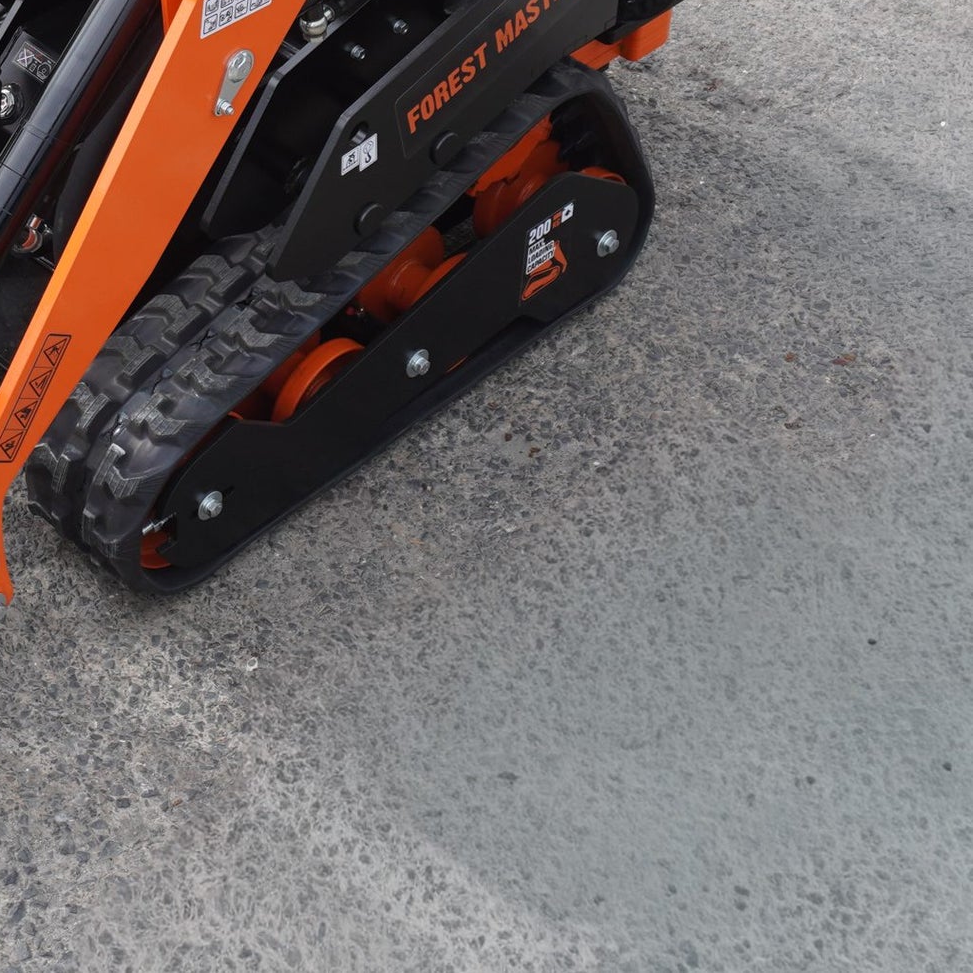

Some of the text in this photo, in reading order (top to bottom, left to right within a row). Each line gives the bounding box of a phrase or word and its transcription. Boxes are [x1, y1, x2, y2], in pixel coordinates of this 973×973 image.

[407, 42, 487, 134] FOREST
[528, 218, 552, 245] 200
[527, 252, 554, 272] CAPACITY
[528, 243, 554, 264] LOADING
